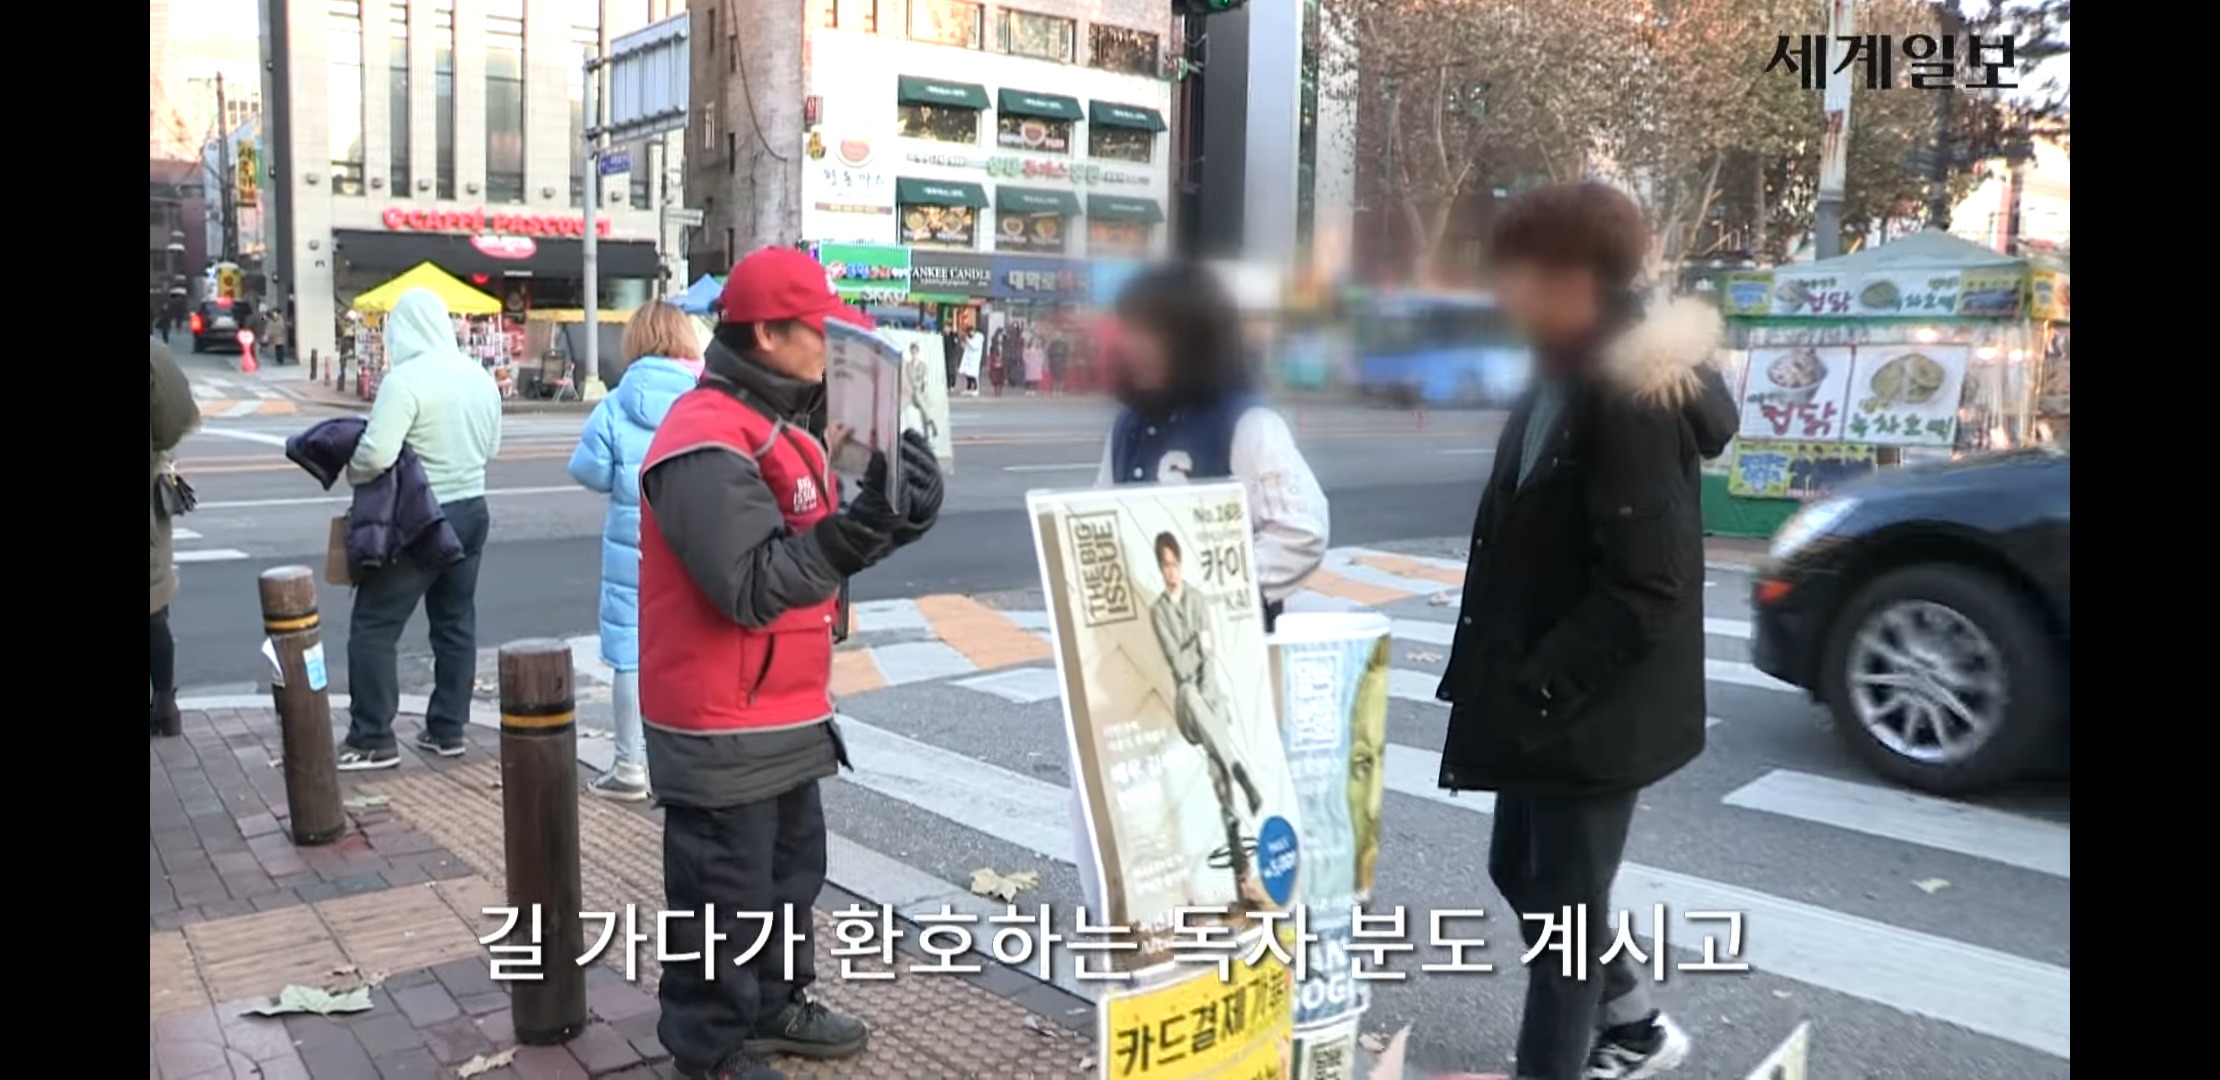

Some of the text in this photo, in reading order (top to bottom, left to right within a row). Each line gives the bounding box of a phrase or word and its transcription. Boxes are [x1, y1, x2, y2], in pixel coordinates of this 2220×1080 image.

[409, 207, 611, 237] CAFFÉ PASCUCI
[911, 265, 948, 279] ANKEE
[1074, 521, 1107, 618] THE BIG
[1093, 520, 1130, 615] ISSUE
[1201, 540, 1250, 586] 카이
[1115, 969, 1287, 1077] 카드결제가능
